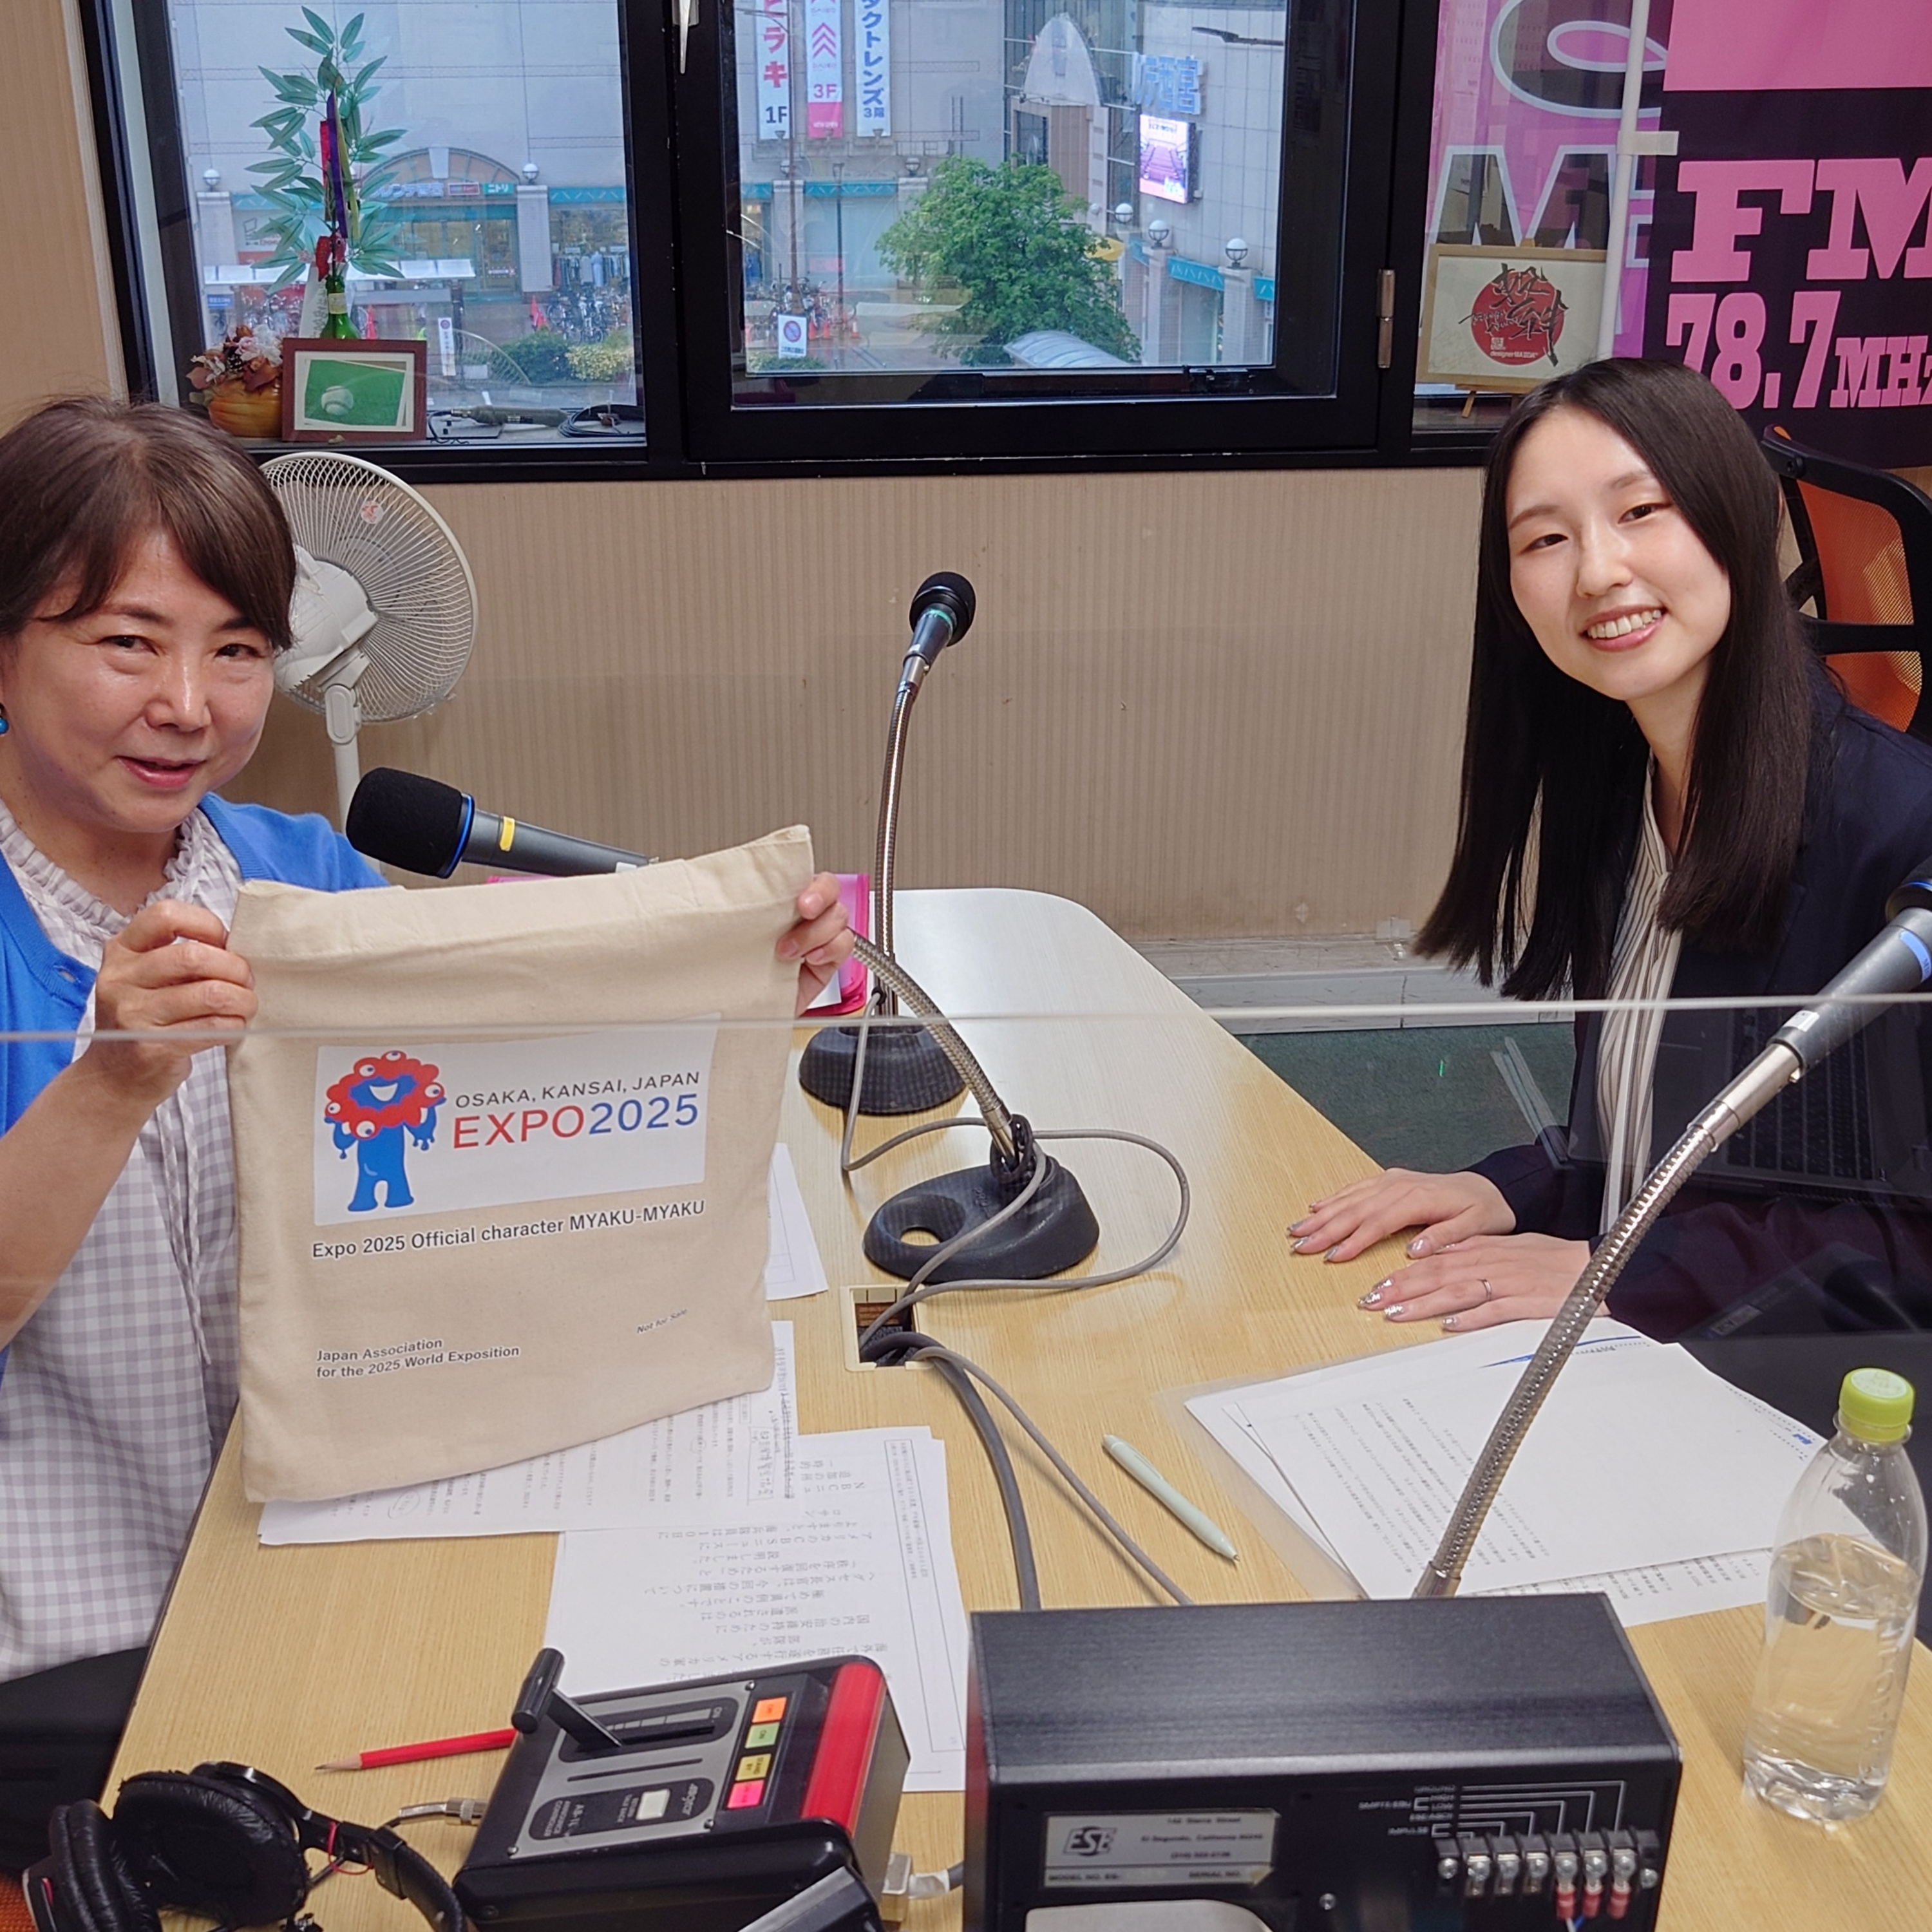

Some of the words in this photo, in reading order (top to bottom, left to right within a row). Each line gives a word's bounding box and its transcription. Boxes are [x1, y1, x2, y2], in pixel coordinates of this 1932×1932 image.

[813, 84, 837, 98] 3F
[766, 106, 788, 124] 1F
[1671, 158, 1932, 283] FM
[455, 1089, 536, 1108] OSAKA,
[542, 1079, 627, 1099] KANSAI,
[632, 1071, 700, 1090] JAPAN
[313, 1243, 357, 1259] Expo
[363, 1235, 405, 1253] 2025
[412, 1227, 475, 1249] Official
[481, 1220, 564, 1241] character
[570, 1200, 705, 1231] MYAKU-MYAKU
[316, 1350, 358, 1363] Japan
[362, 1339, 443, 1359] Association
[316, 1367, 337, 1378] for
[341, 1366, 364, 1377] the
[368, 1359, 401, 1375] 2025
[404, 1353, 444, 1368] World
[448, 1347, 520, 1363] Exposition
[1063, 1826, 1117, 1856] ESE
